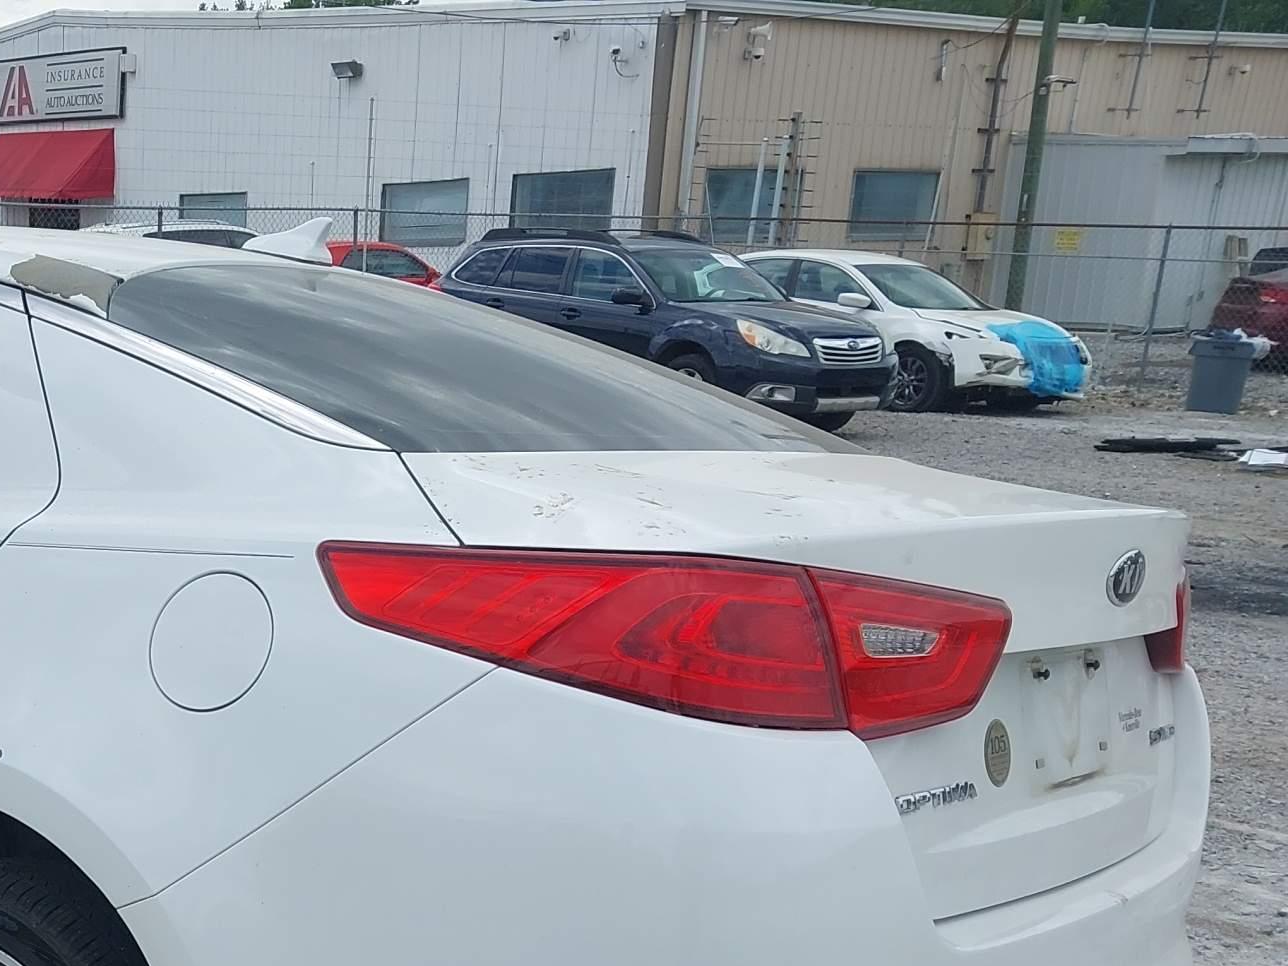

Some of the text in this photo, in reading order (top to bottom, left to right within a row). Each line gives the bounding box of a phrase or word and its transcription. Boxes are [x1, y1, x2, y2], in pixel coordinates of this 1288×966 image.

[46, 66, 105, 83] INSURANCE
[45, 93, 104, 108] AUTO AUCTIONS
[990, 734, 1007, 755] 105
[894, 781, 978, 816] OPTIMA
